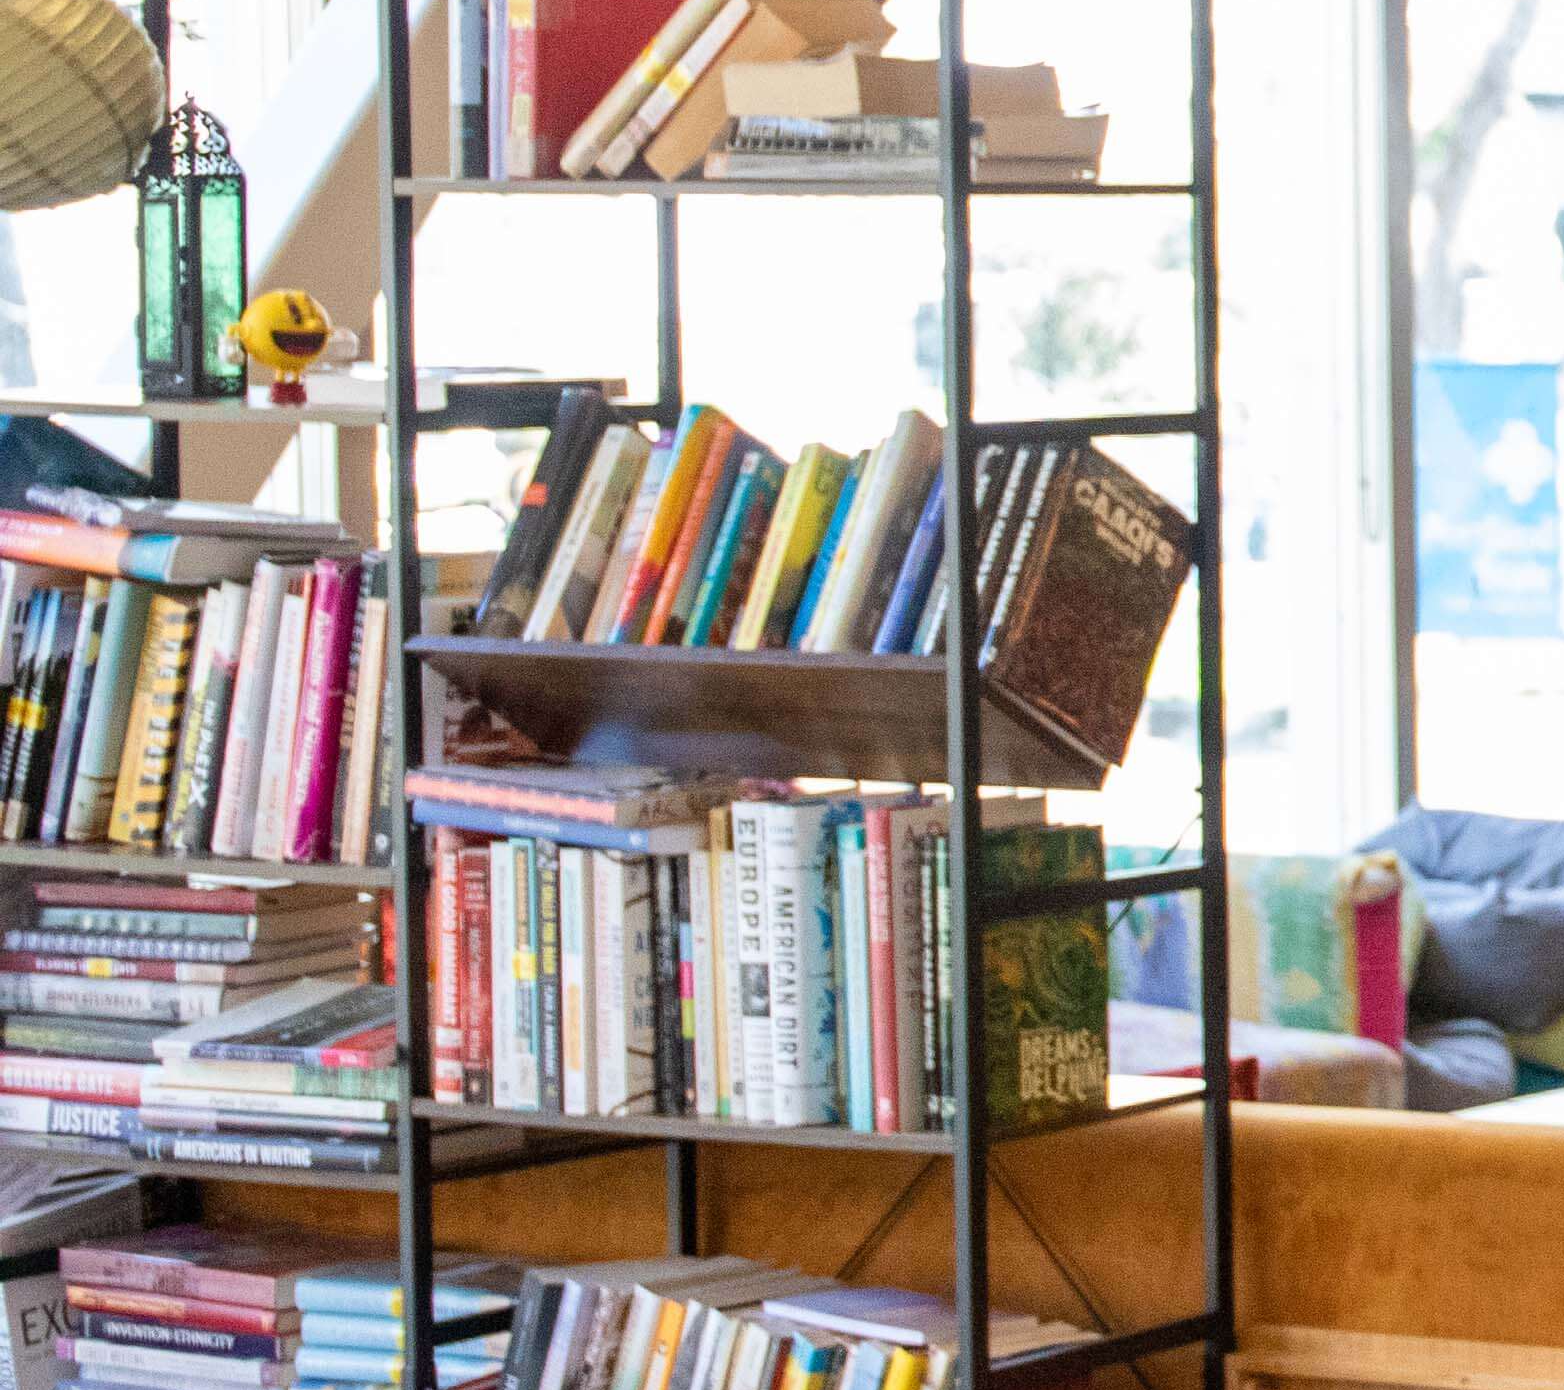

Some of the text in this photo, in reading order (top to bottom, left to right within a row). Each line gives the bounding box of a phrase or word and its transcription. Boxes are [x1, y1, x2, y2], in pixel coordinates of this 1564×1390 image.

[737, 816, 762, 954] EUROPE
[773, 883, 801, 1072] AMERICAN DIRT
[51, 1107, 121, 1138] JUSTICE
[174, 1139, 312, 1167] AMERICANS IN WAITING
